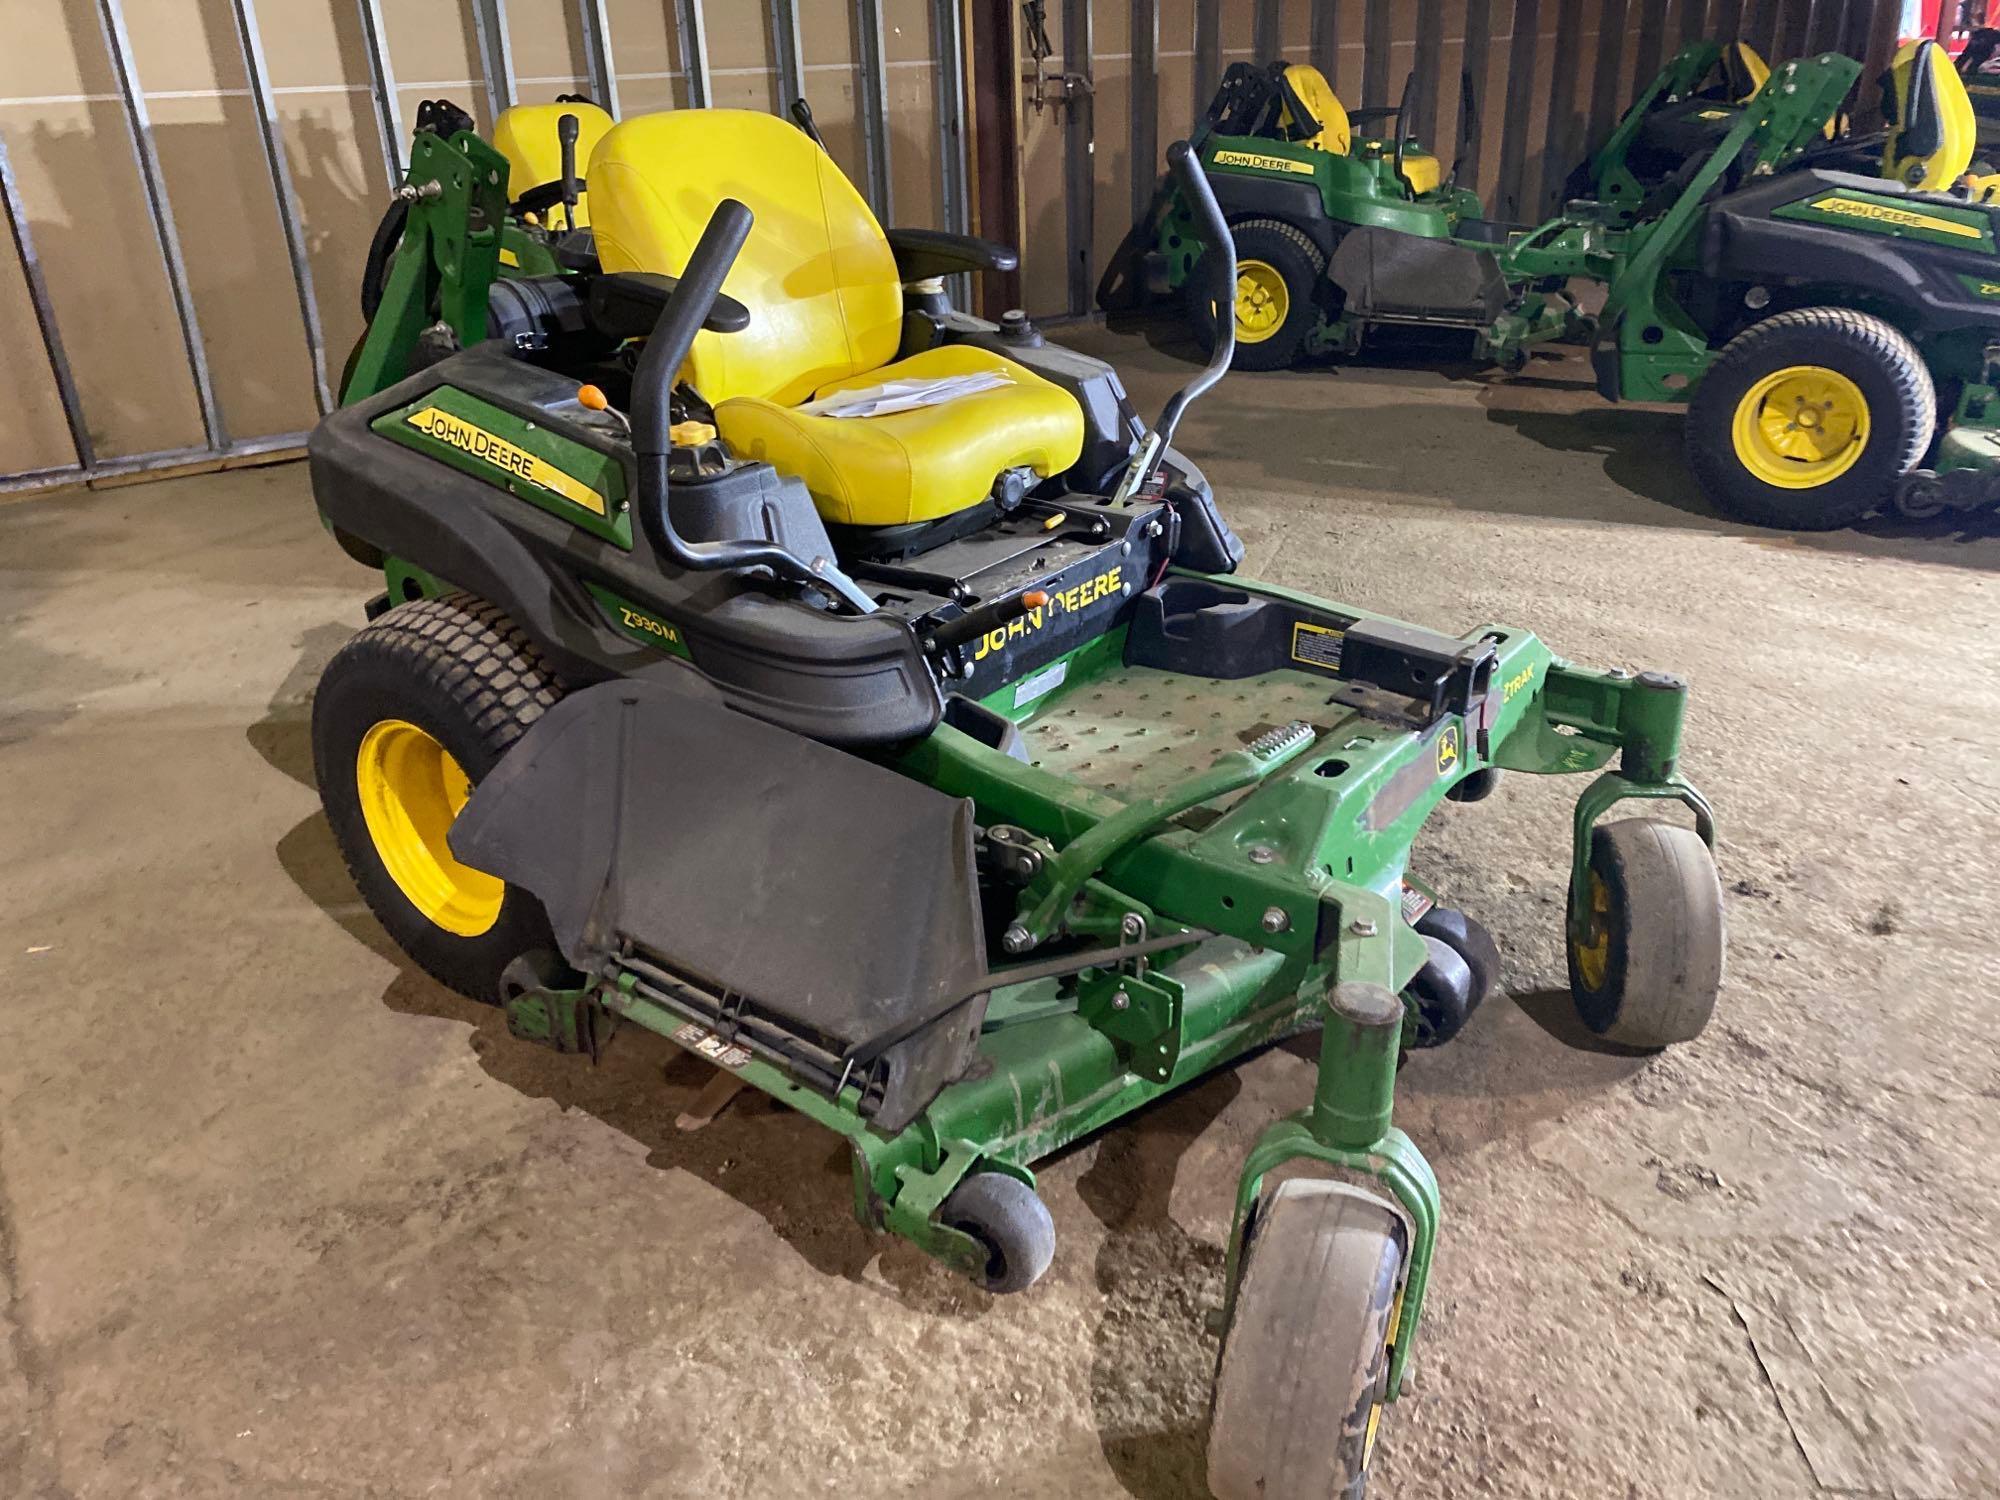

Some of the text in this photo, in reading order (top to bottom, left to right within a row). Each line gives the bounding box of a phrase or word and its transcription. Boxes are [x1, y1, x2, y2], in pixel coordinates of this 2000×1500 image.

[1222, 153, 1292, 170] JOHN DEERE
[1827, 200, 1922, 225] JOHN DEERE
[424, 412, 534, 478] JOHN DEERE
[620, 607, 678, 643] Z930M
